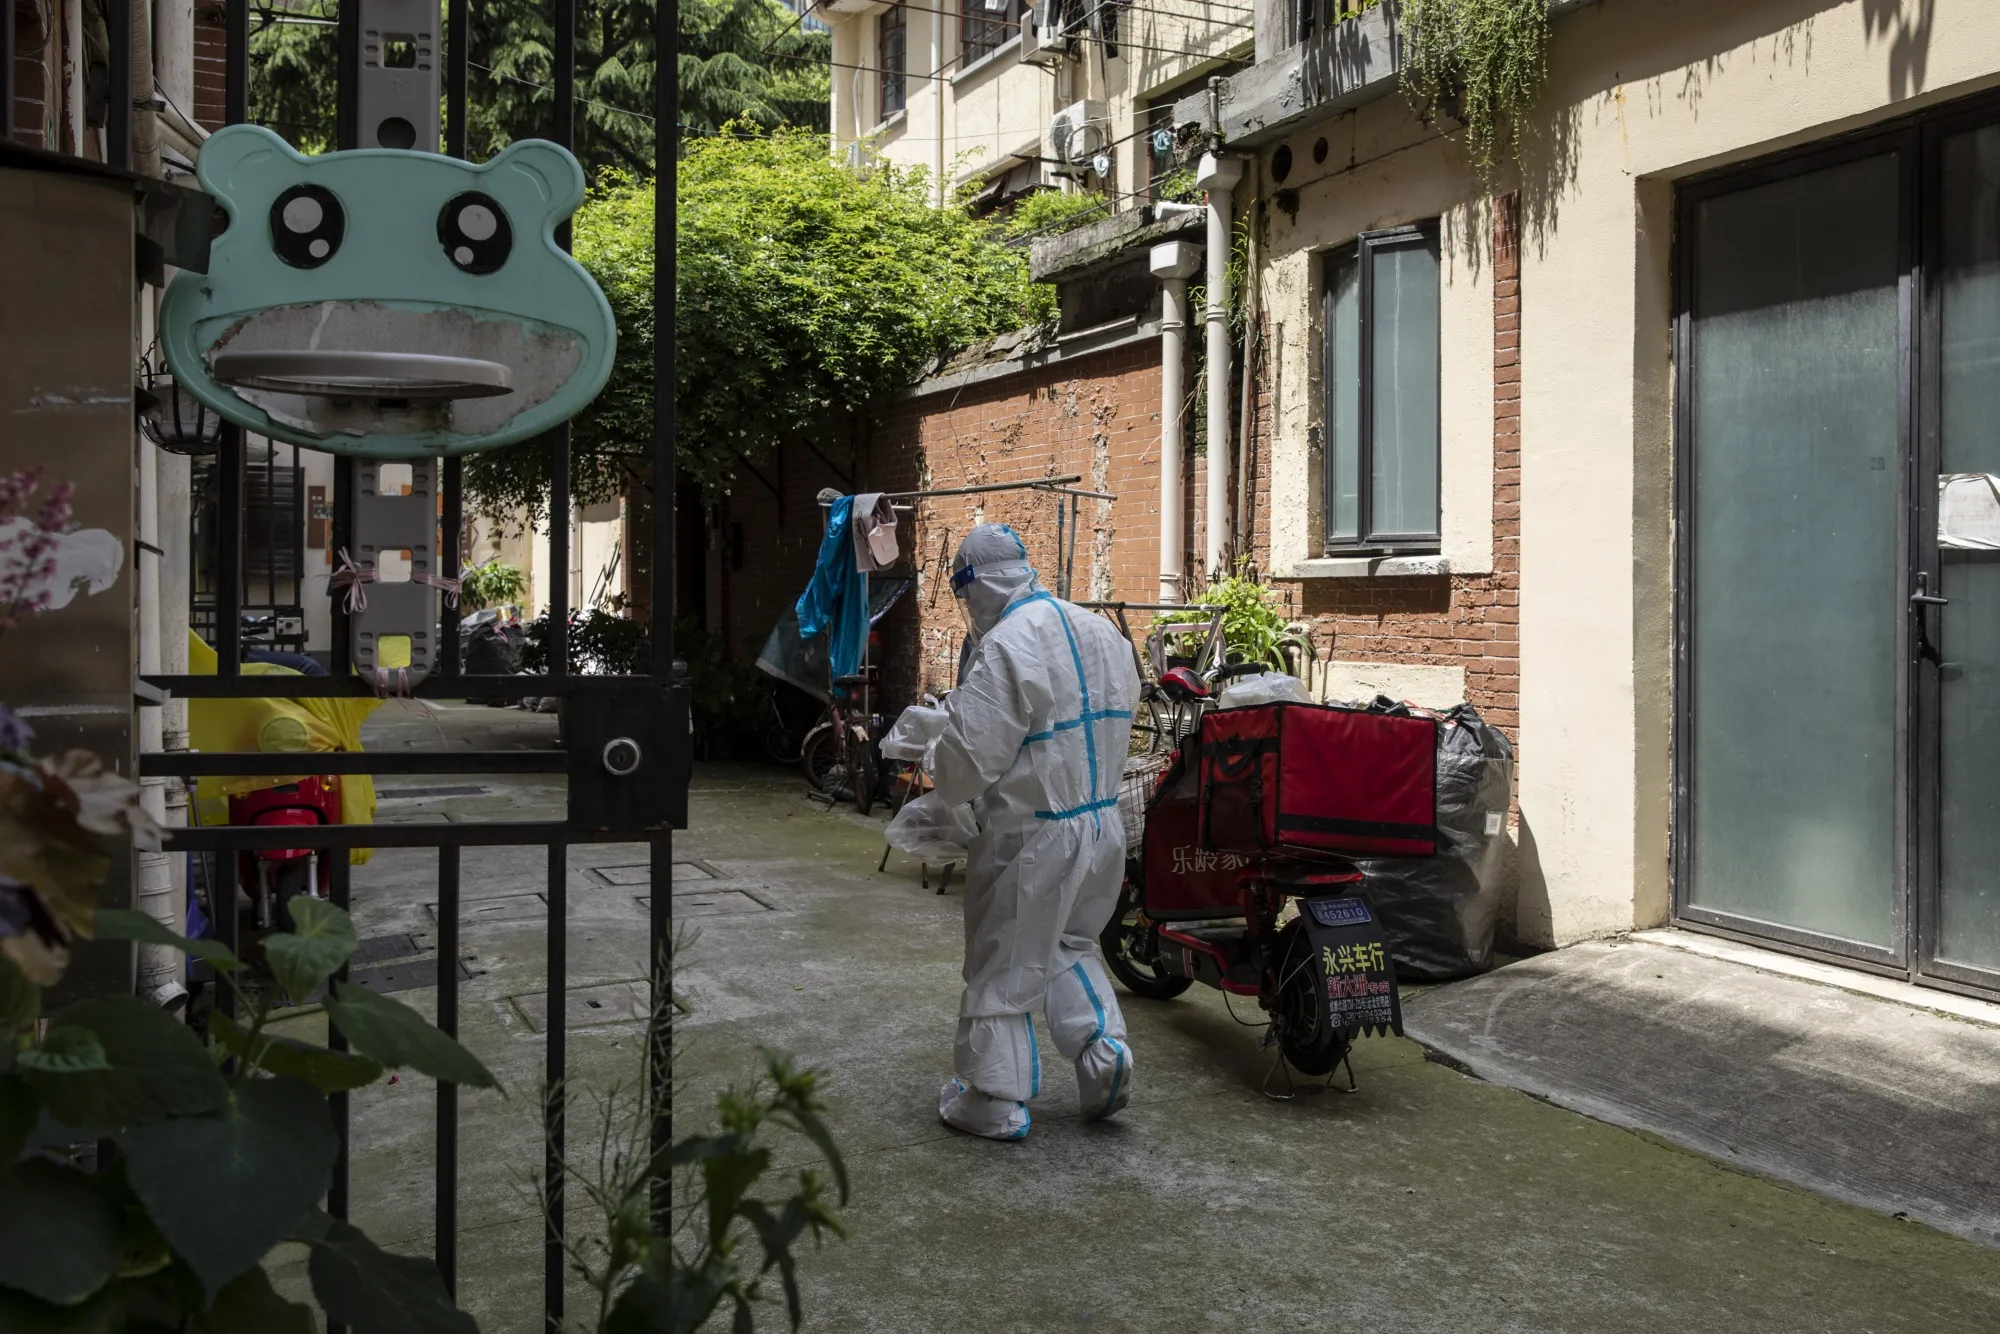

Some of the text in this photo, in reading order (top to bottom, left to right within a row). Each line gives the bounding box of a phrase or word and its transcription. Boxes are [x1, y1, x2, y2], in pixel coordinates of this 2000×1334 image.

[1171, 845, 1249, 874] 乐龄家
[1322, 942, 1385, 975] 永兴车行
